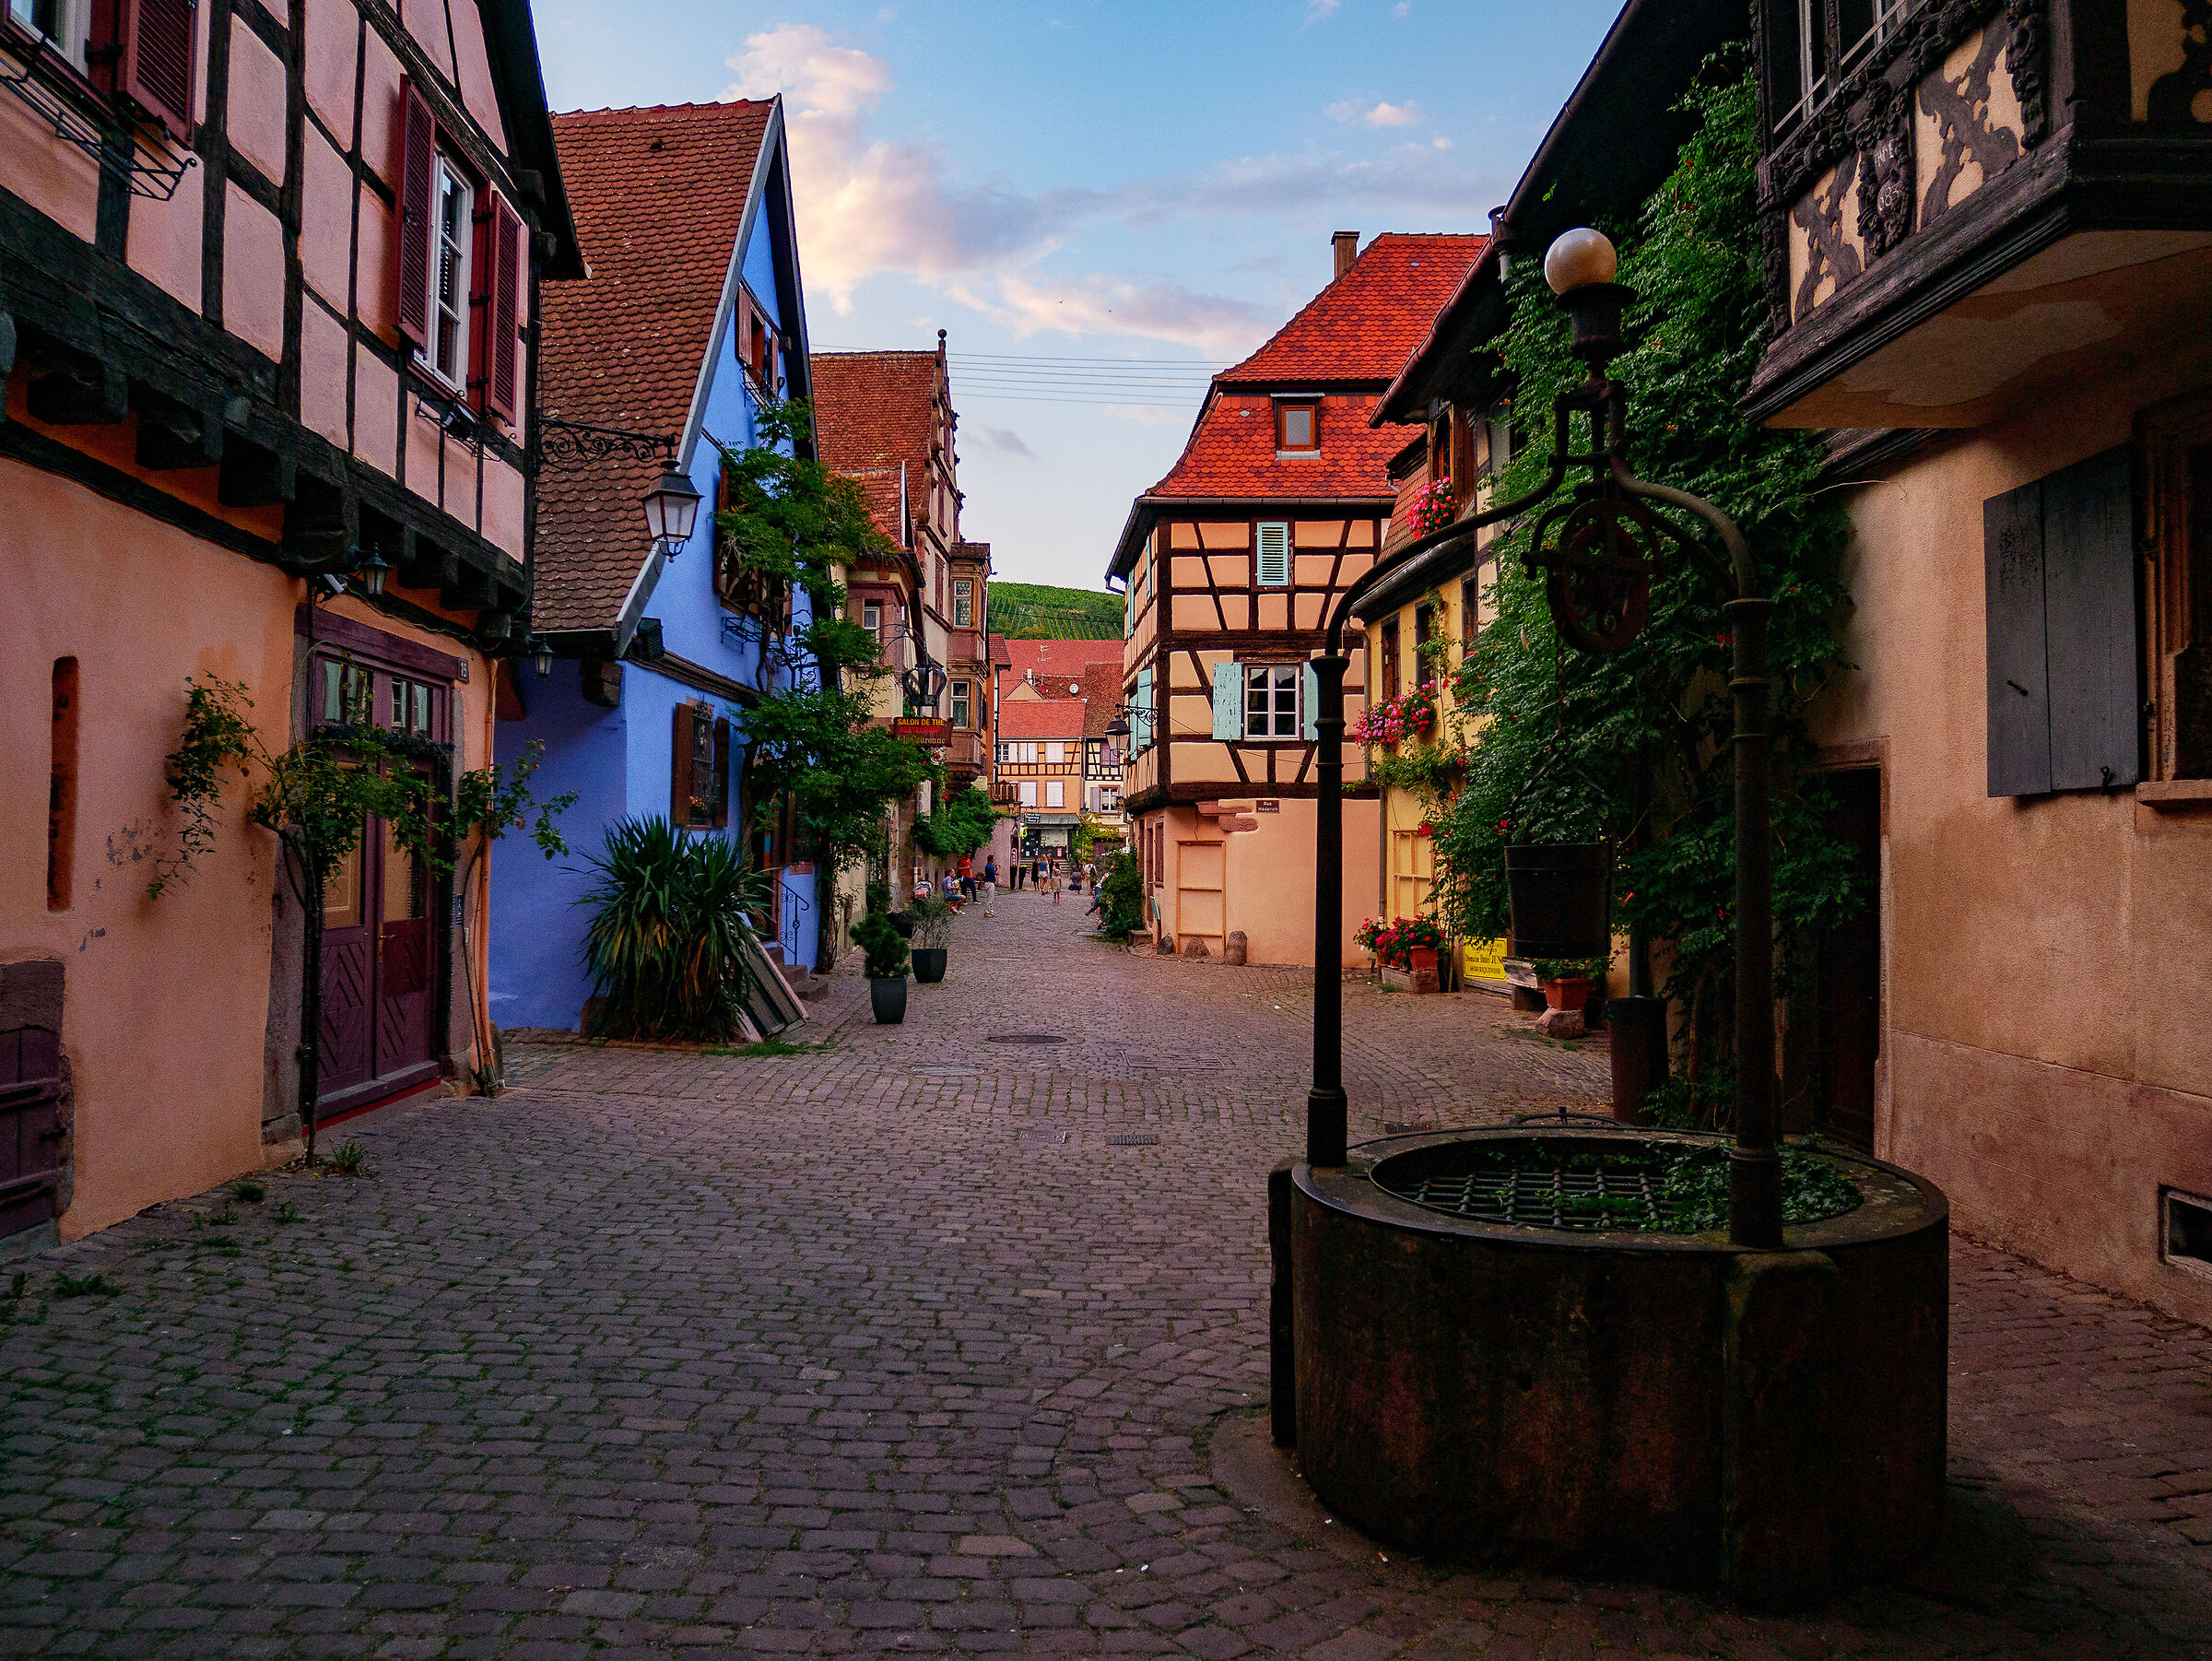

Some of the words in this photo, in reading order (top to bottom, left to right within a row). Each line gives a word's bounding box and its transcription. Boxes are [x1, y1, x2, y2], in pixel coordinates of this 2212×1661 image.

[461, 662, 467, 677] 15
[898, 718, 919, 726] SALON
[922, 718, 930, 726] DE
[932, 718, 945, 726] THE
[899, 725, 941, 734] RESTAURANT
